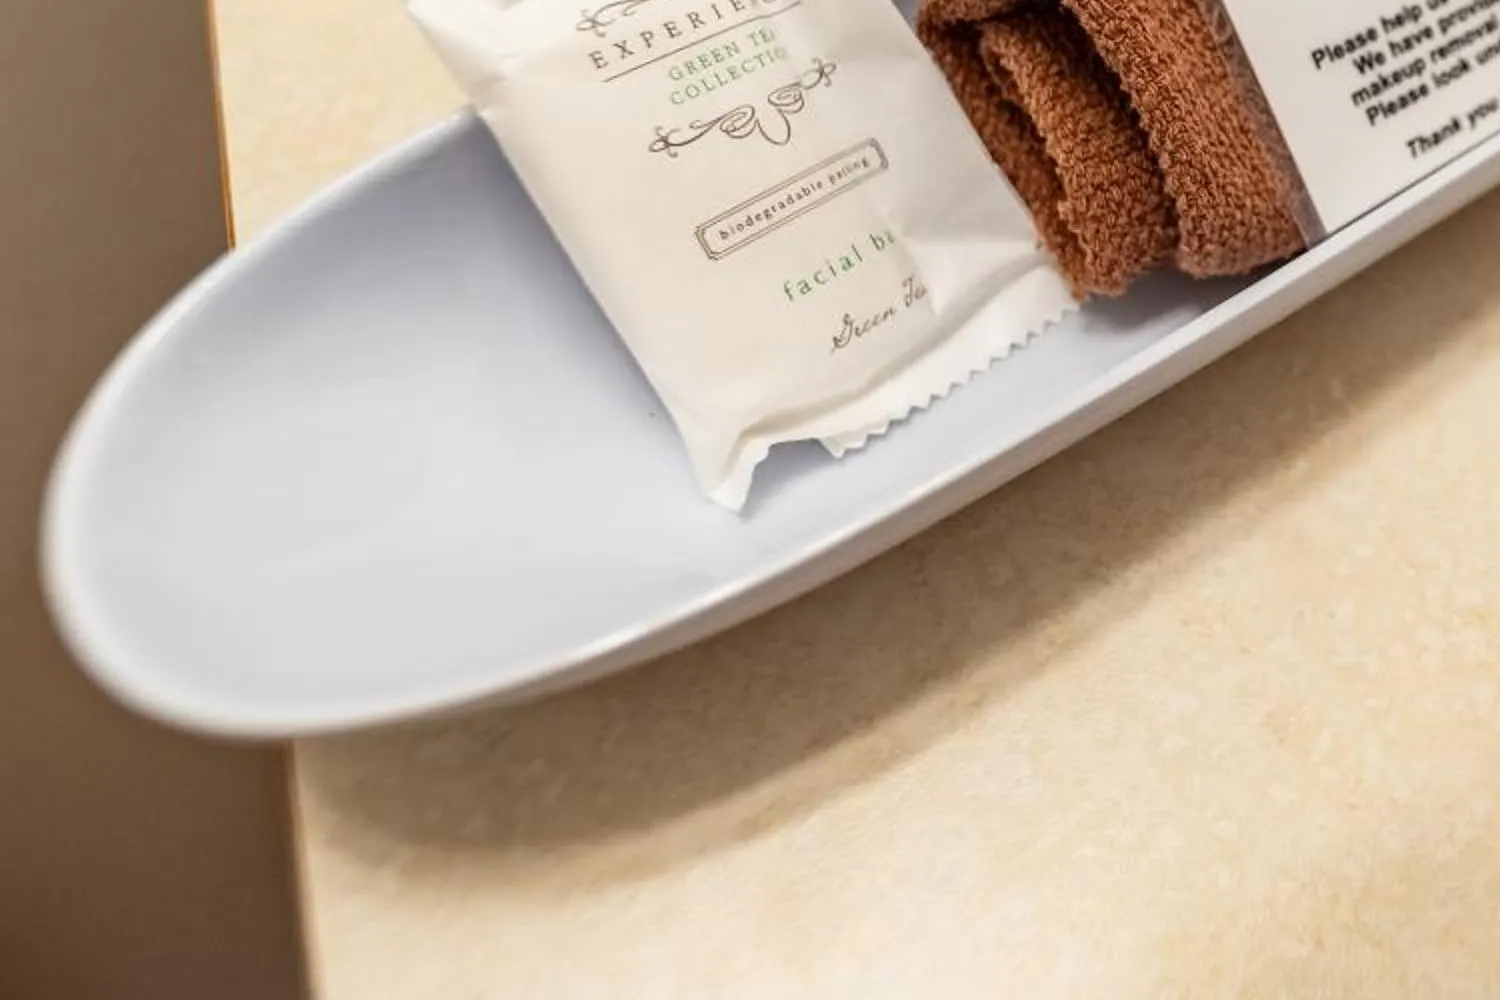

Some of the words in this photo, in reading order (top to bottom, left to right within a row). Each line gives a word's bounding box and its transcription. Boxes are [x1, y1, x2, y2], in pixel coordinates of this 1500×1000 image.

[669, 41, 742, 81] GREEN
[1311, 27, 1378, 70] Please
[1380, 4, 1423, 34] help
[1351, 57, 1427, 108] makeup
[1430, 13, 1499, 64] removal
[1352, 51, 1387, 76] We
[1388, 26, 1434, 58] have
[670, 46, 789, 105] COLLECTIO
[1364, 83, 1430, 127] Please
[1432, 58, 1471, 89] look
[1406, 117, 1462, 159] Thank
[1467, 98, 1499, 130] you
[719, 180, 824, 241] biodegradable
[782, 243, 864, 301] facial
[831, 306, 897, 352] Green
